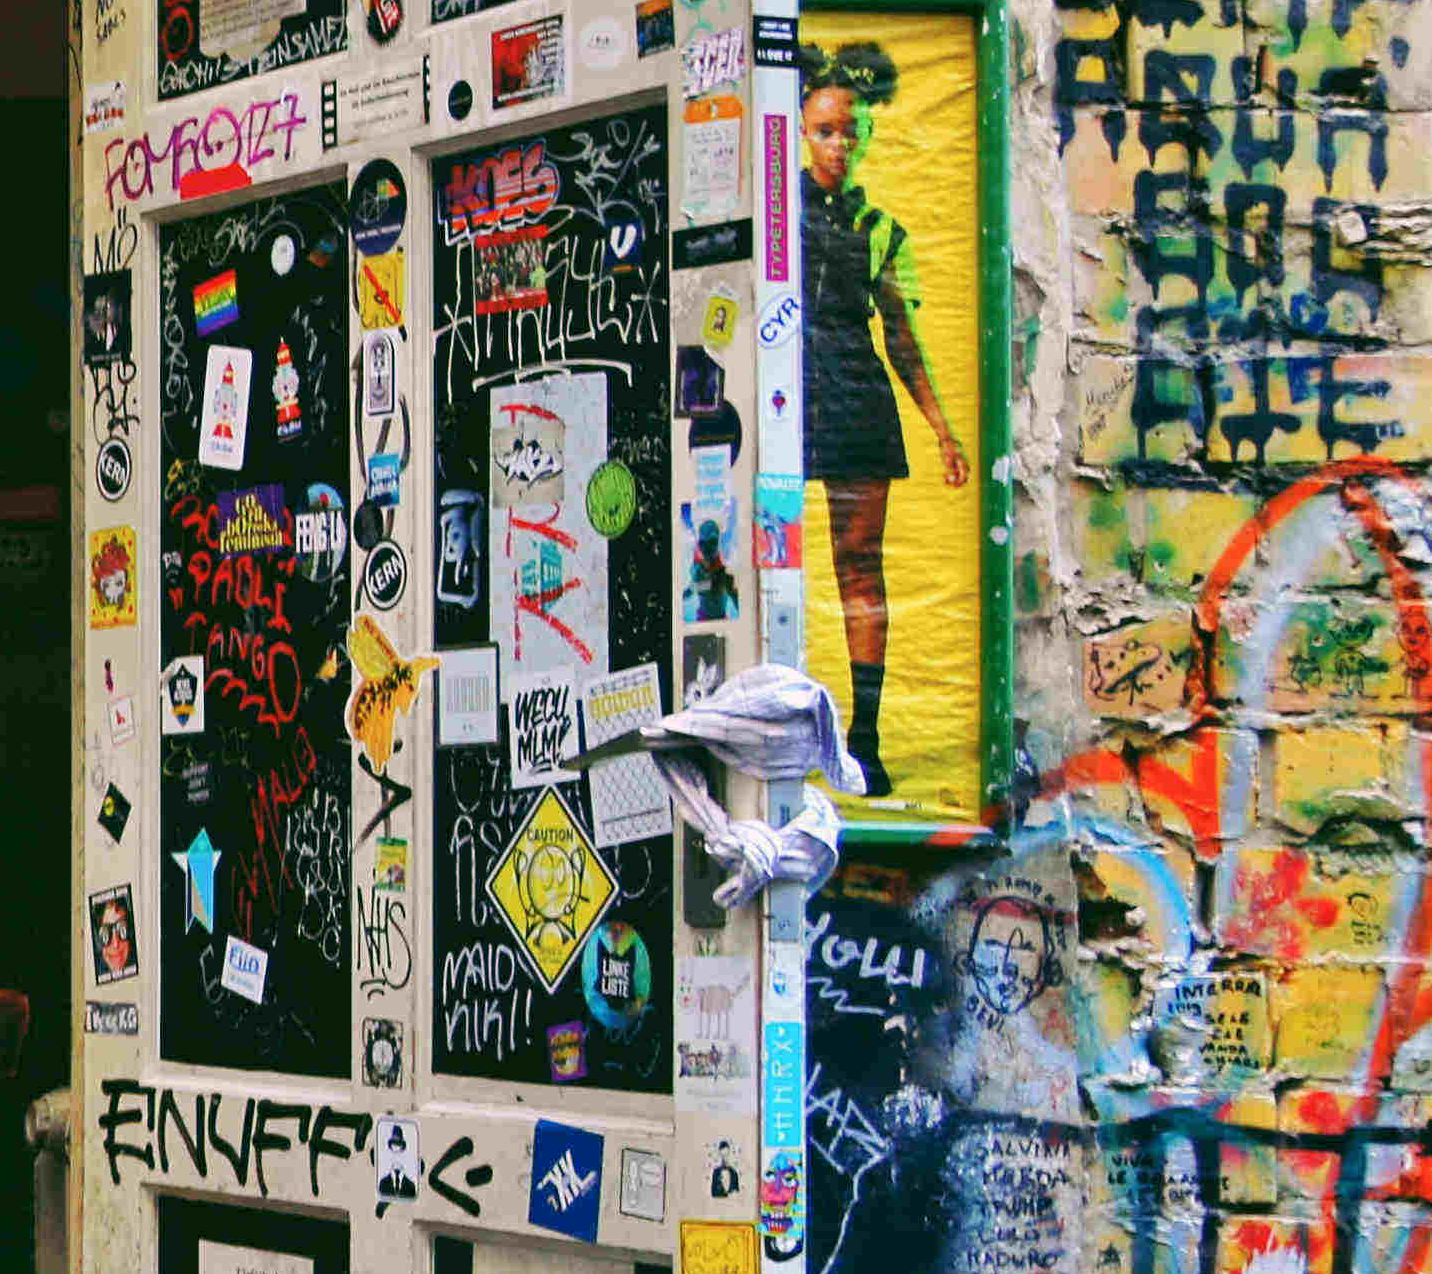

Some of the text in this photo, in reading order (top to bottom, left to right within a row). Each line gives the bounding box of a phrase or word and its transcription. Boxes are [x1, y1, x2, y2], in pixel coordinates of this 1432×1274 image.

[759, 296, 800, 344] CYR
[369, 551, 406, 596] KERN
[526, 826, 575, 844] CAUTION
